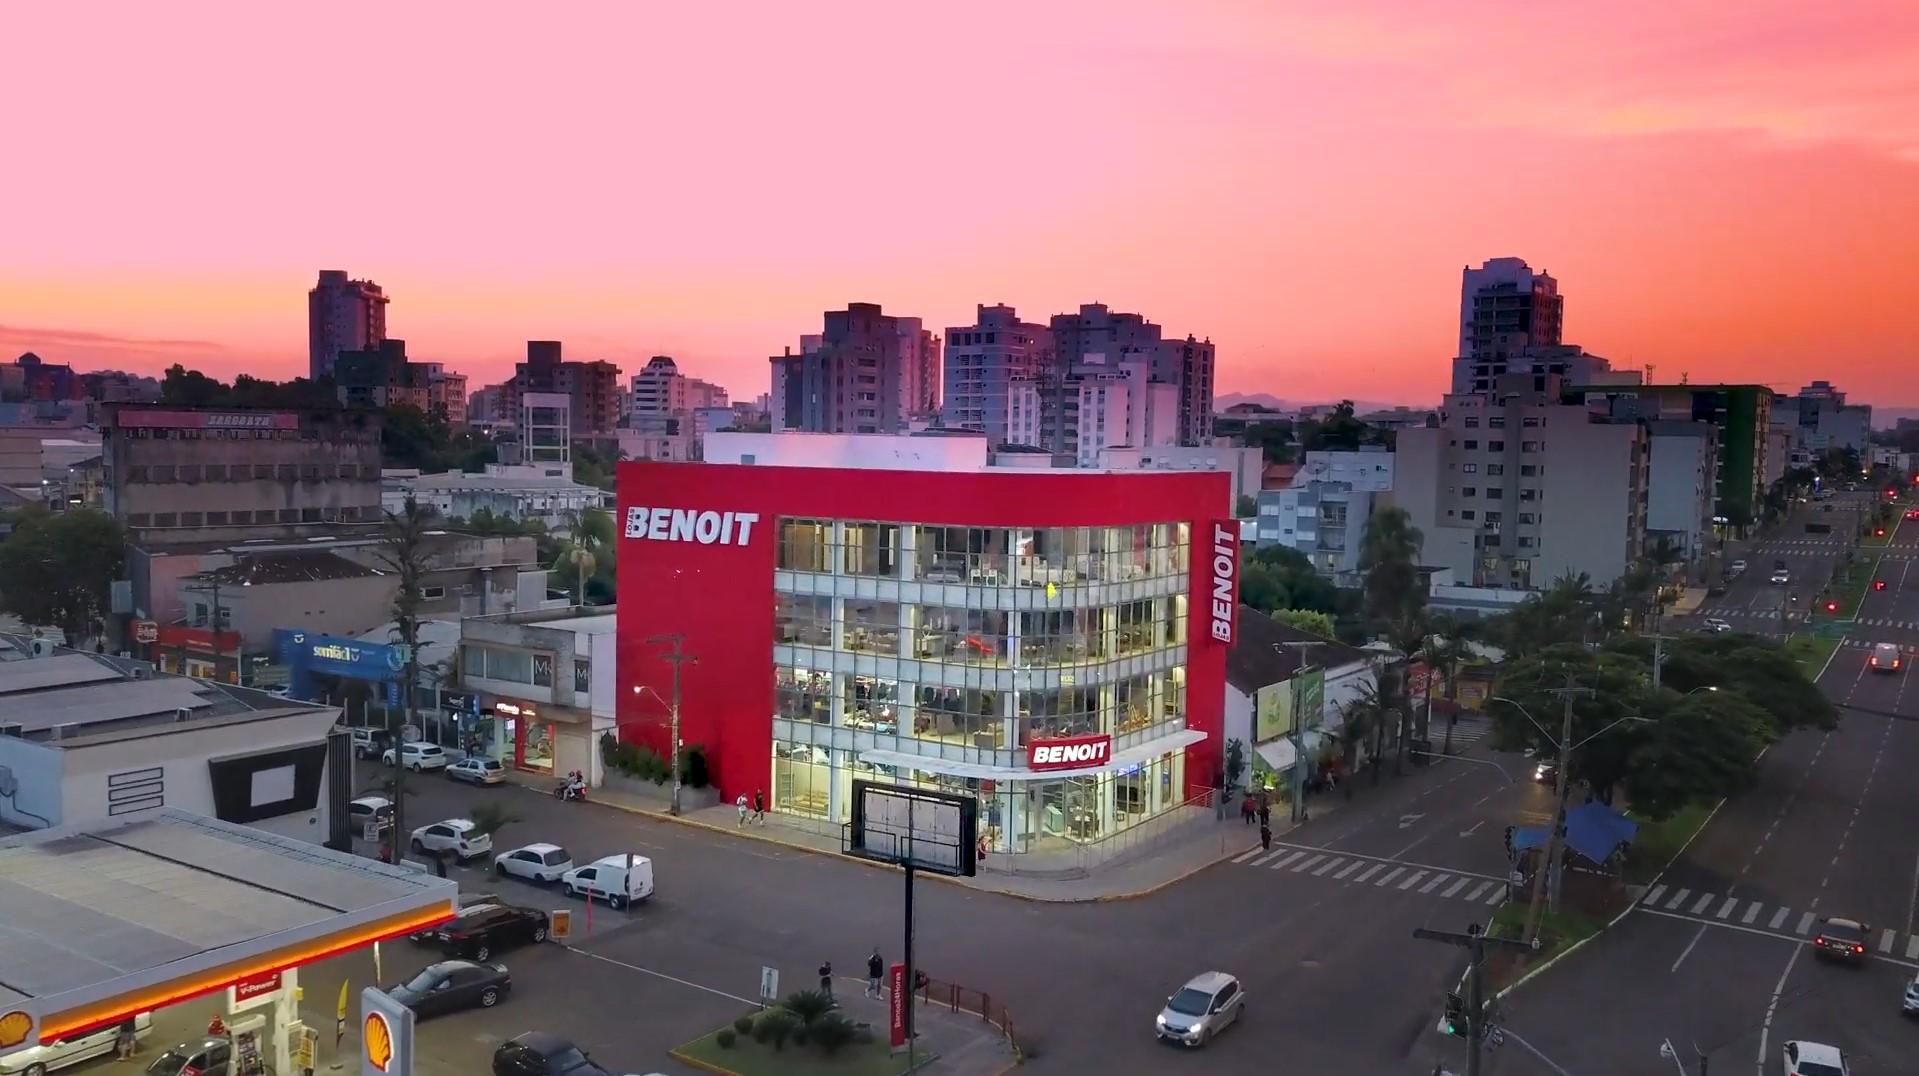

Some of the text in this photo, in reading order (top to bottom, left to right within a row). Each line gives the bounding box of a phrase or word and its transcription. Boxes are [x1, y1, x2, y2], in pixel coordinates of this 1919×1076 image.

[624, 506, 760, 546] LOJAS BENOIT
[1212, 523, 1234, 643] BENOIT
[1033, 741, 1107, 764] BENOIT
